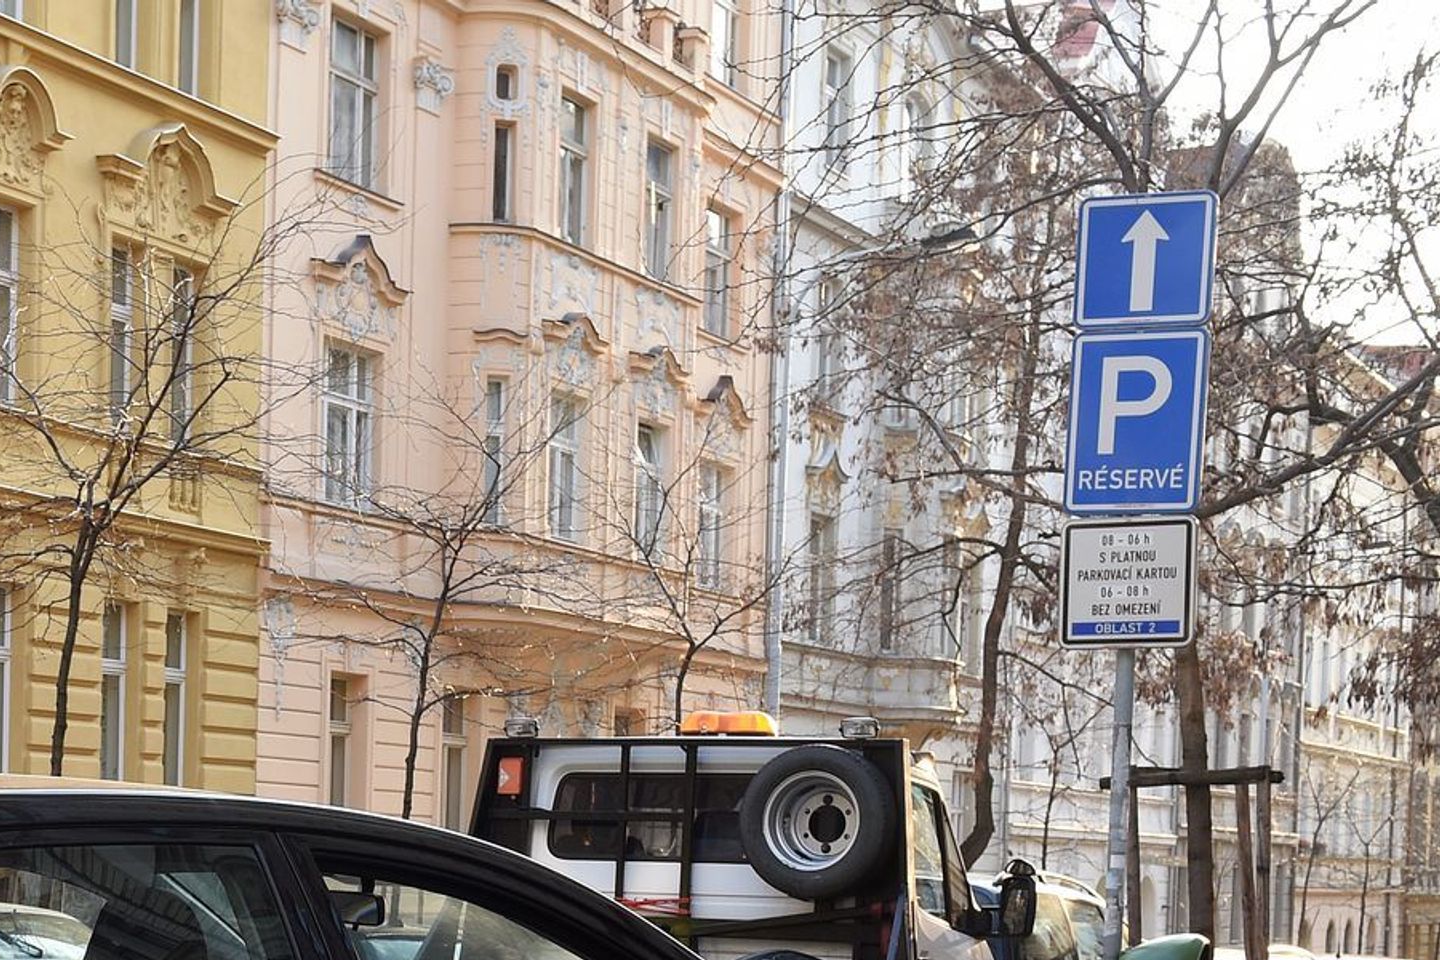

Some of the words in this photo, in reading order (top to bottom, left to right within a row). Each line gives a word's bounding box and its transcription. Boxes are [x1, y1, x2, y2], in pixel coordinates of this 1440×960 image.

[1098, 356, 1172, 455] P
[1078, 463, 1184, 490] RÉSERVÉ
[1102, 534, 1113, 546] 08
[1128, 534, 1140, 545] 06
[1144, 533, 1150, 544] h
[1099, 552, 1106, 563] S
[1110, 550, 1156, 563] PLATNOU
[1078, 566, 1133, 581] PARKOVACÍ
[1136, 566, 1178, 580] KARTOU
[1100, 586, 1113, 598] 06
[1126, 585, 1138, 597] 08
[1142, 585, 1149, 596] h
[1091, 604, 1110, 616] BEZ
[1115, 601, 1161, 616] OMEZENÍ
[1095, 623, 1143, 634] OBLAST
[1148, 622, 1155, 633] 2
